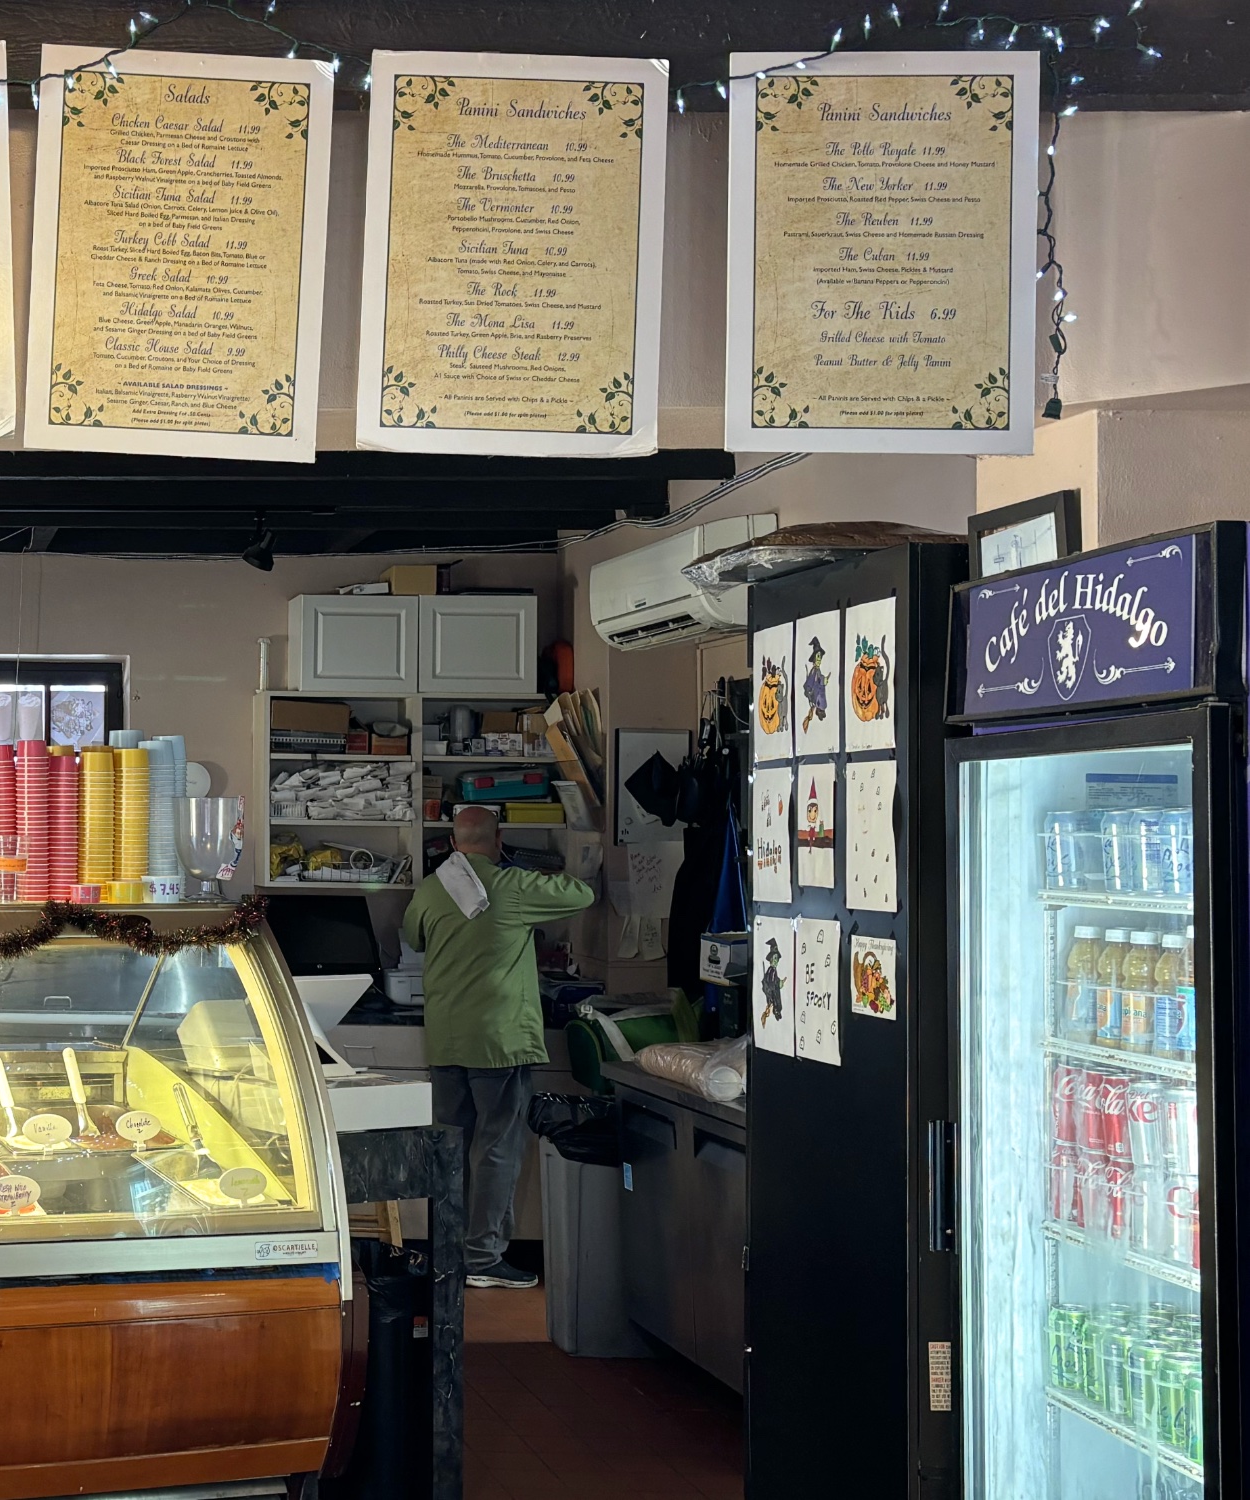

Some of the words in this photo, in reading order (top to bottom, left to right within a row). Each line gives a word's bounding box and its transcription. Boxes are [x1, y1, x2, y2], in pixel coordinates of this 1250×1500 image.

[164, 84, 211, 104] Salads
[456, 97, 499, 117] Panini
[506, 99, 587, 120] Sandwiches
[817, 103, 862, 121] Panini
[869, 103, 952, 121] Sandwiches
[110, 113, 150, 128] Chicken
[155, 114, 189, 131] Caesar
[194, 117, 224, 133] Salad
[239, 125, 260, 134] 11.99
[445, 133, 466, 149] The
[471, 134, 549, 150] Mediterranean
[566, 143, 587, 152] 10.99
[457, 166, 477, 180] The
[482, 166, 536, 182] Bruschetta
[553, 174, 575, 183] 10.99
[823, 177, 843, 191] The
[846, 177, 874, 191] New
[879, 177, 914, 191] Yorker
[925, 182, 947, 191] 11.99
[111, 185, 151, 200] Sicilian
[156, 187, 181, 202] Tuna
[186, 189, 216, 204] Salad
[231, 196, 252, 205] 11.99
[839, 247, 859, 261] The
[864, 247, 895, 261] Cuban
[907, 252, 929, 261] 11.99
[129, 266, 158, 281] Greek
[162, 268, 192, 283] Salad
[207, 275, 228, 284] 10.99
[467, 282, 486, 296] The
[491, 282, 518, 298] Rock
[534, 289, 556, 298] 11.99
[120, 302, 163, 320] Hidalgo
[168, 304, 198, 319] Salad
[213, 311, 234, 321] 10.99
[811, 301, 837, 319] For
[844, 301, 871, 320] The
[879, 301, 915, 320] Kids
[931, 308, 956, 320] 6.99
[820, 330, 852, 343] Grilled
[855, 331, 885, 343] Cheese
[889, 331, 908, 343] with
[913, 331, 945, 344] Tomato
[438, 344, 468, 364] Philly
[471, 345, 508, 360] Cheese
[512, 346, 541, 361] Steak
[558, 352, 580, 362] 12.99
[985, 588, 1030, 673] Café
[1035, 570, 1069, 625] del
[1072, 572, 1168, 648] Hidalgo
[805, 962, 815, 985] BE
